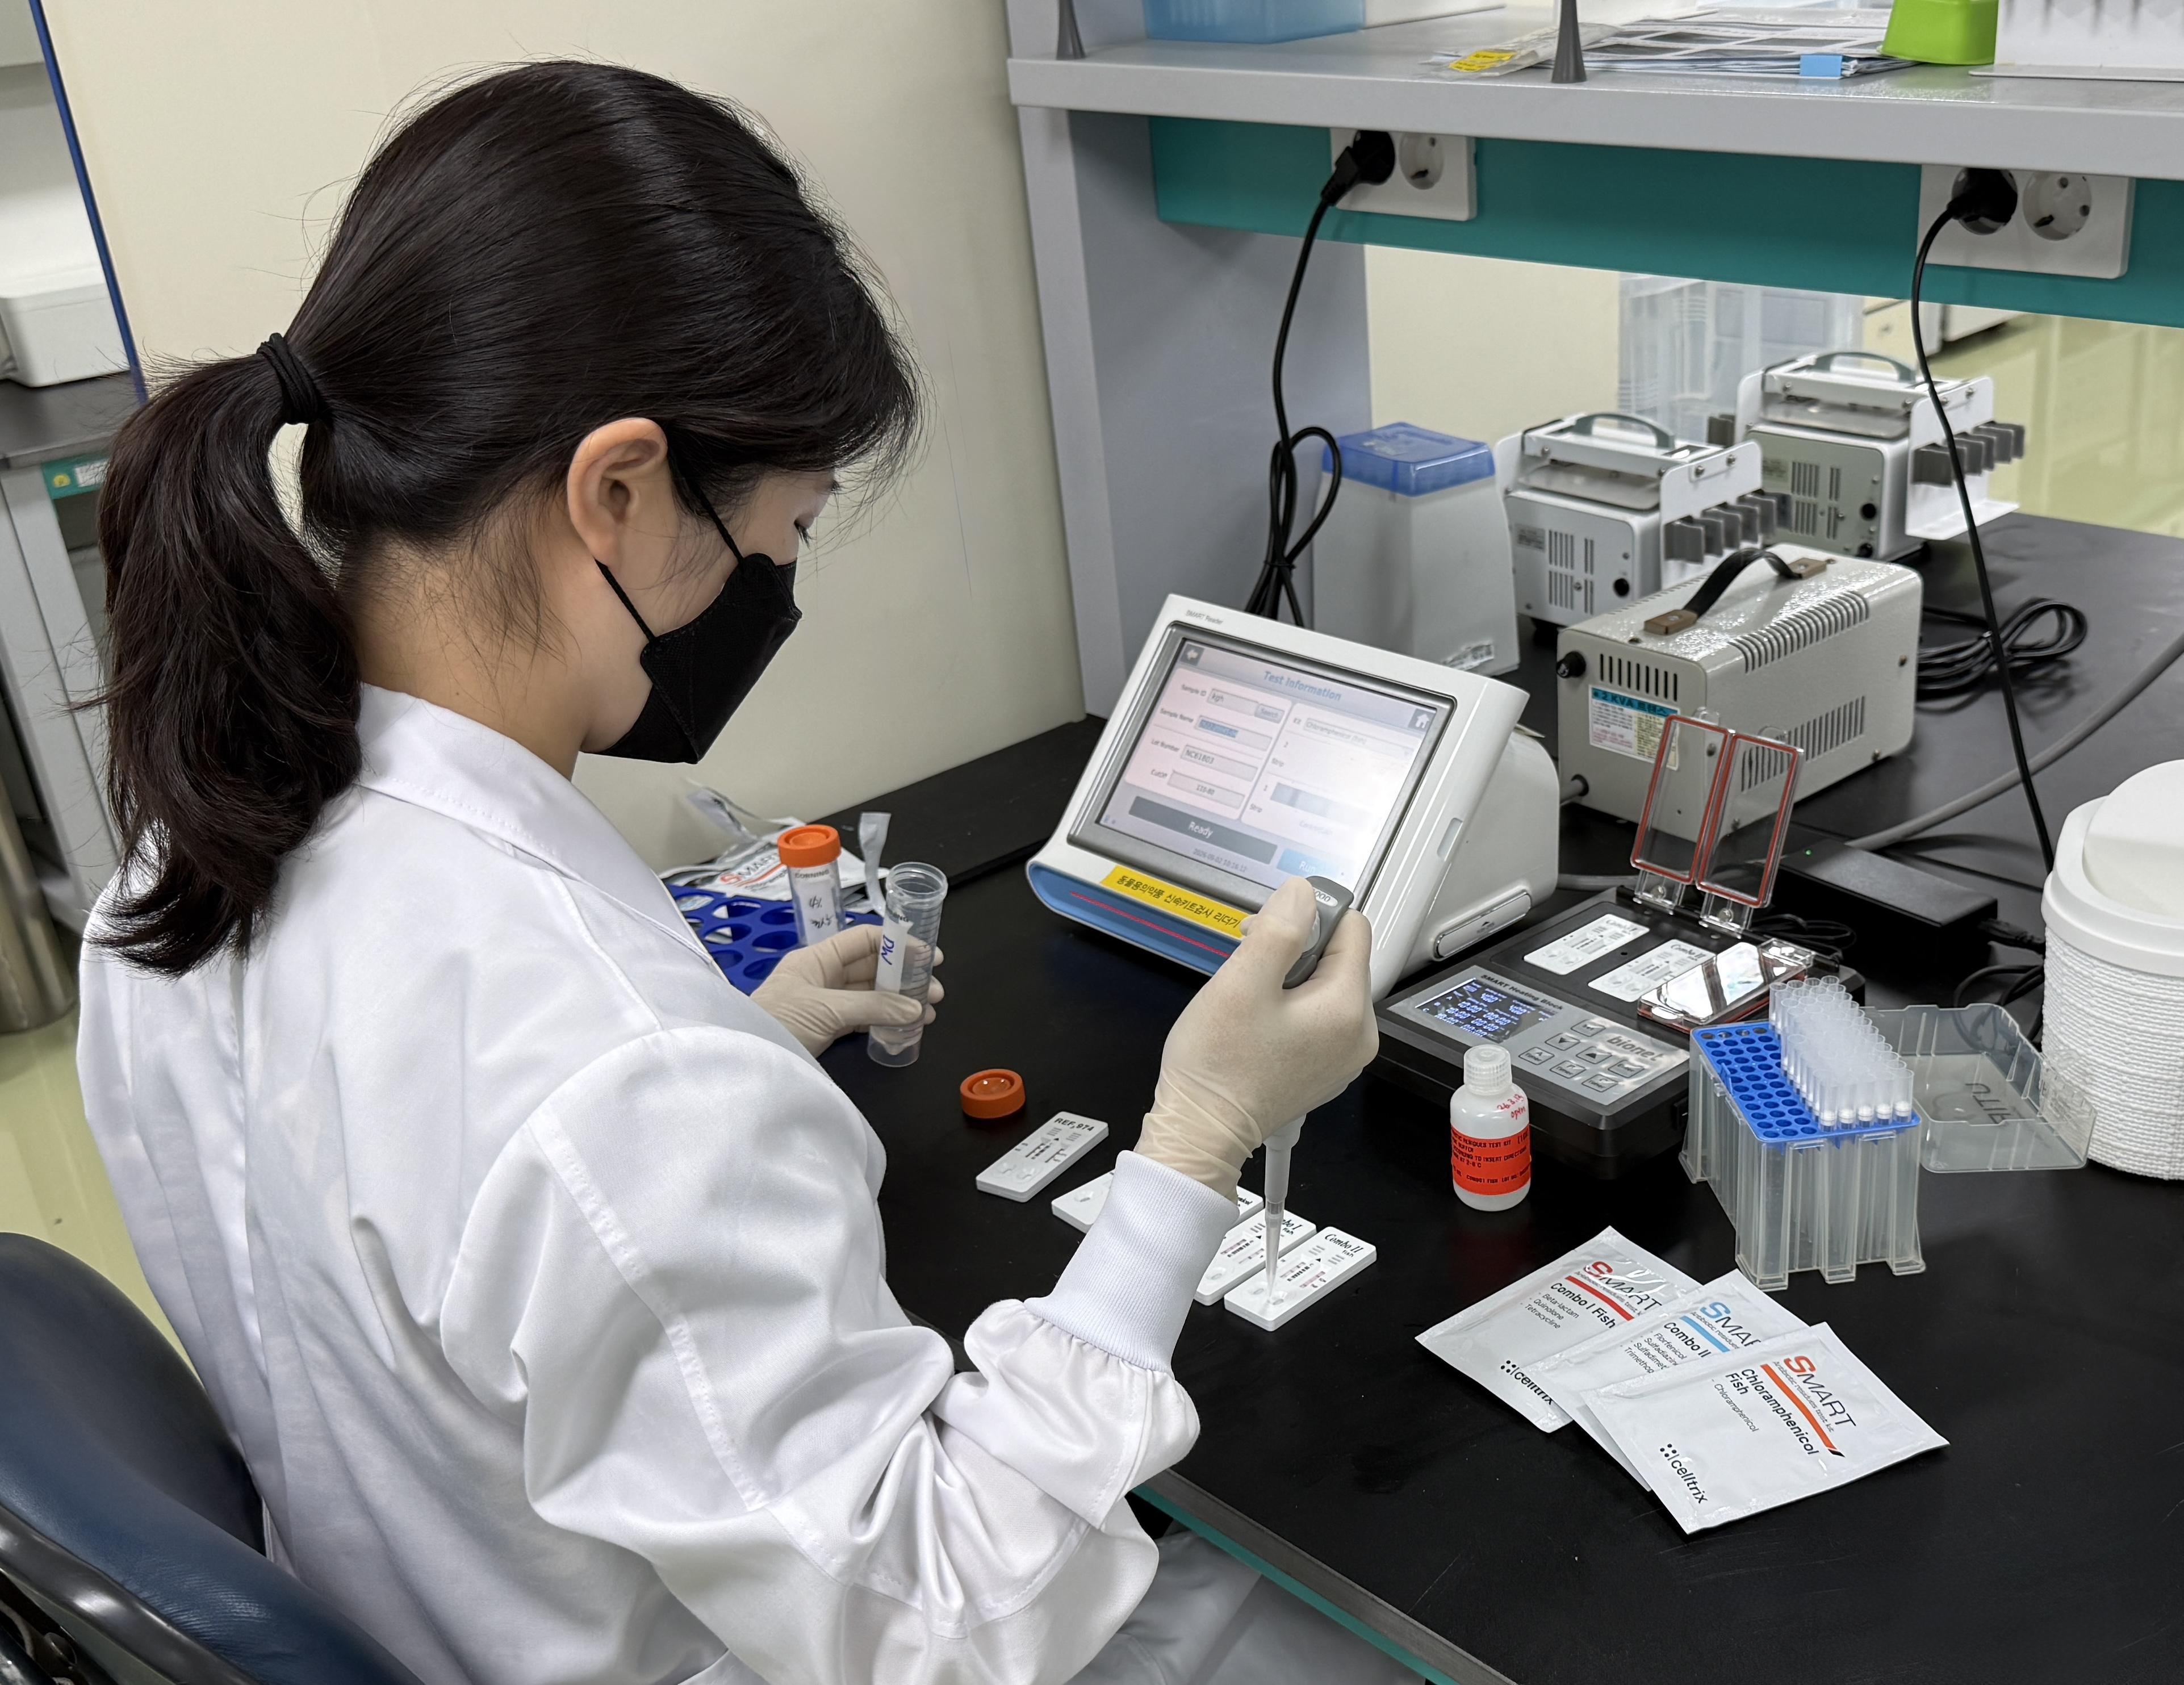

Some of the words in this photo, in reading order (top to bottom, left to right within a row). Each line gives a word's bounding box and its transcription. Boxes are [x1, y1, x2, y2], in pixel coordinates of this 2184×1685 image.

[1263, 671, 1283, 685] Test
[1188, 821, 1214, 839] Ready
[1299, 861, 1316, 873] Run
[1116, 875, 1164, 898] 동물용의약품
[1166, 891, 1214, 919] 신속키트검사
[881, 934, 894, 965] DW
[1480, 974, 1509, 988] SMART
[1509, 985, 1540, 1001] Heating
[1540, 998, 1563, 1010] Block
[1607, 1036, 1664, 1062] bionet
[1325, 1233, 1352, 1249] Combo
[1583, 1260, 1663, 1311] SMART
[1525, 1303, 1561, 1329] Tetracycline
[1533, 1298, 1564, 1320] Quinolone
[1542, 1293, 1580, 1319] Beta-lactam
[1550, 1282, 1588, 1306] Combo
[1592, 1307, 1617, 1329] Fish
[1663, 1322, 1700, 1352] Combo
[1700, 1301, 1762, 1347] SMA
[1643, 1337, 1678, 1366] Sulfadiazin
[1654, 1332, 1688, 1360] Florfenicol
[1725, 1372, 1749, 1395] Fish
[1783, 1355, 1856, 1427] SMART
[1714, 1383, 1759, 1432] Chloramphenicol
[1741, 1368, 1819, 1456] Chloramphenicol
[1671, 1460, 1708, 1504] celltrix
